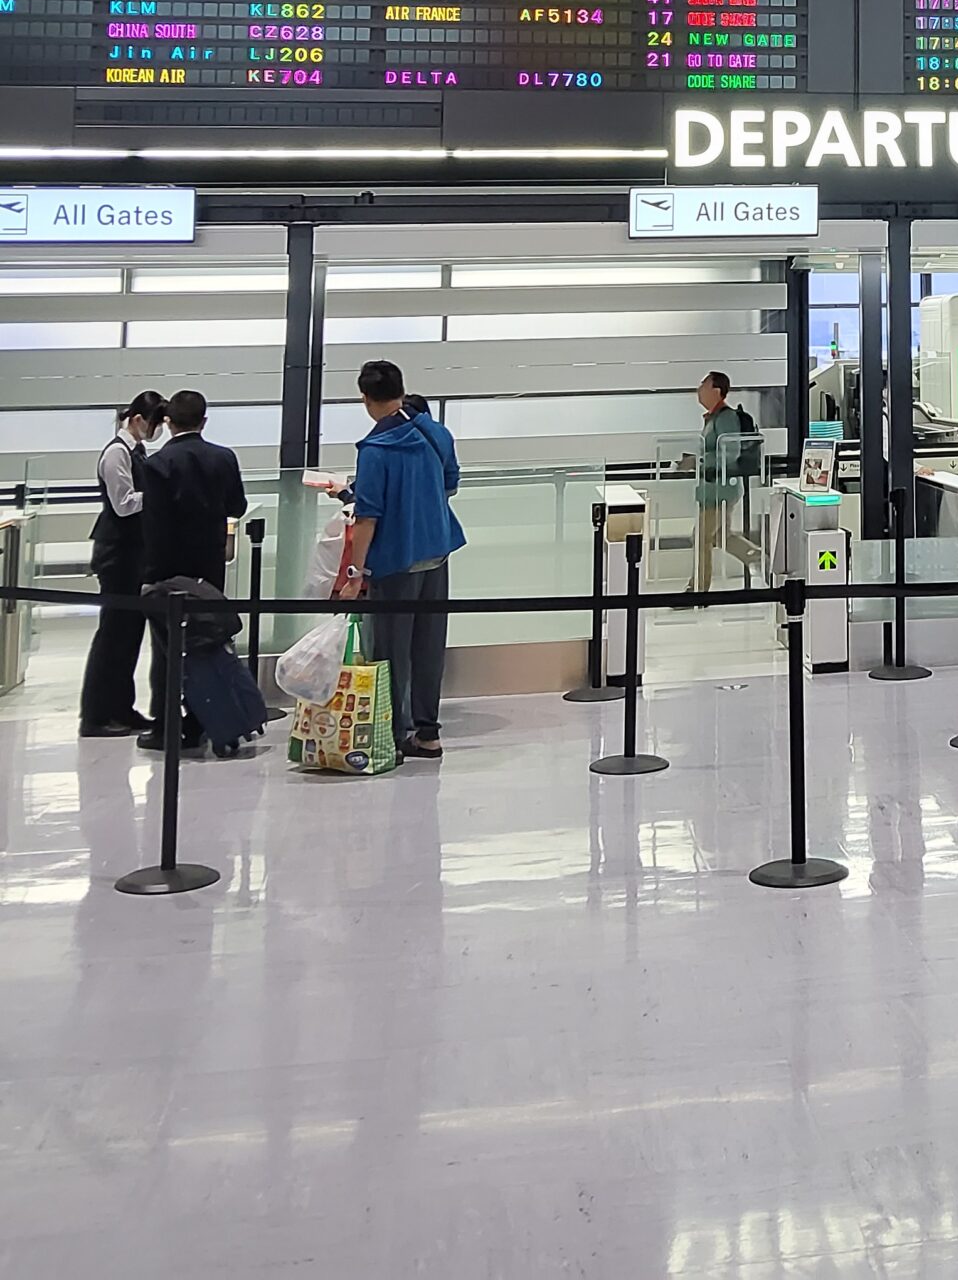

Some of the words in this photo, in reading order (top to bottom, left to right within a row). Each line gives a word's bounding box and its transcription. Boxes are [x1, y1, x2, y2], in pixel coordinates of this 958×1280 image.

[386, 6, 409, 20] AIR
[416, 7, 460, 21] FRANCE
[107, 69, 154, 82] KOREAN
[160, 69, 185, 83] AIR
[249, 70, 322, 84] KE704
[386, 71, 456, 84] DELTA
[519, 73, 601, 86] DL7780
[53, 204, 86, 225] All
[97, 204, 173, 225] Gates
[696, 201, 725, 222] All
[734, 201, 800, 221] Gates
